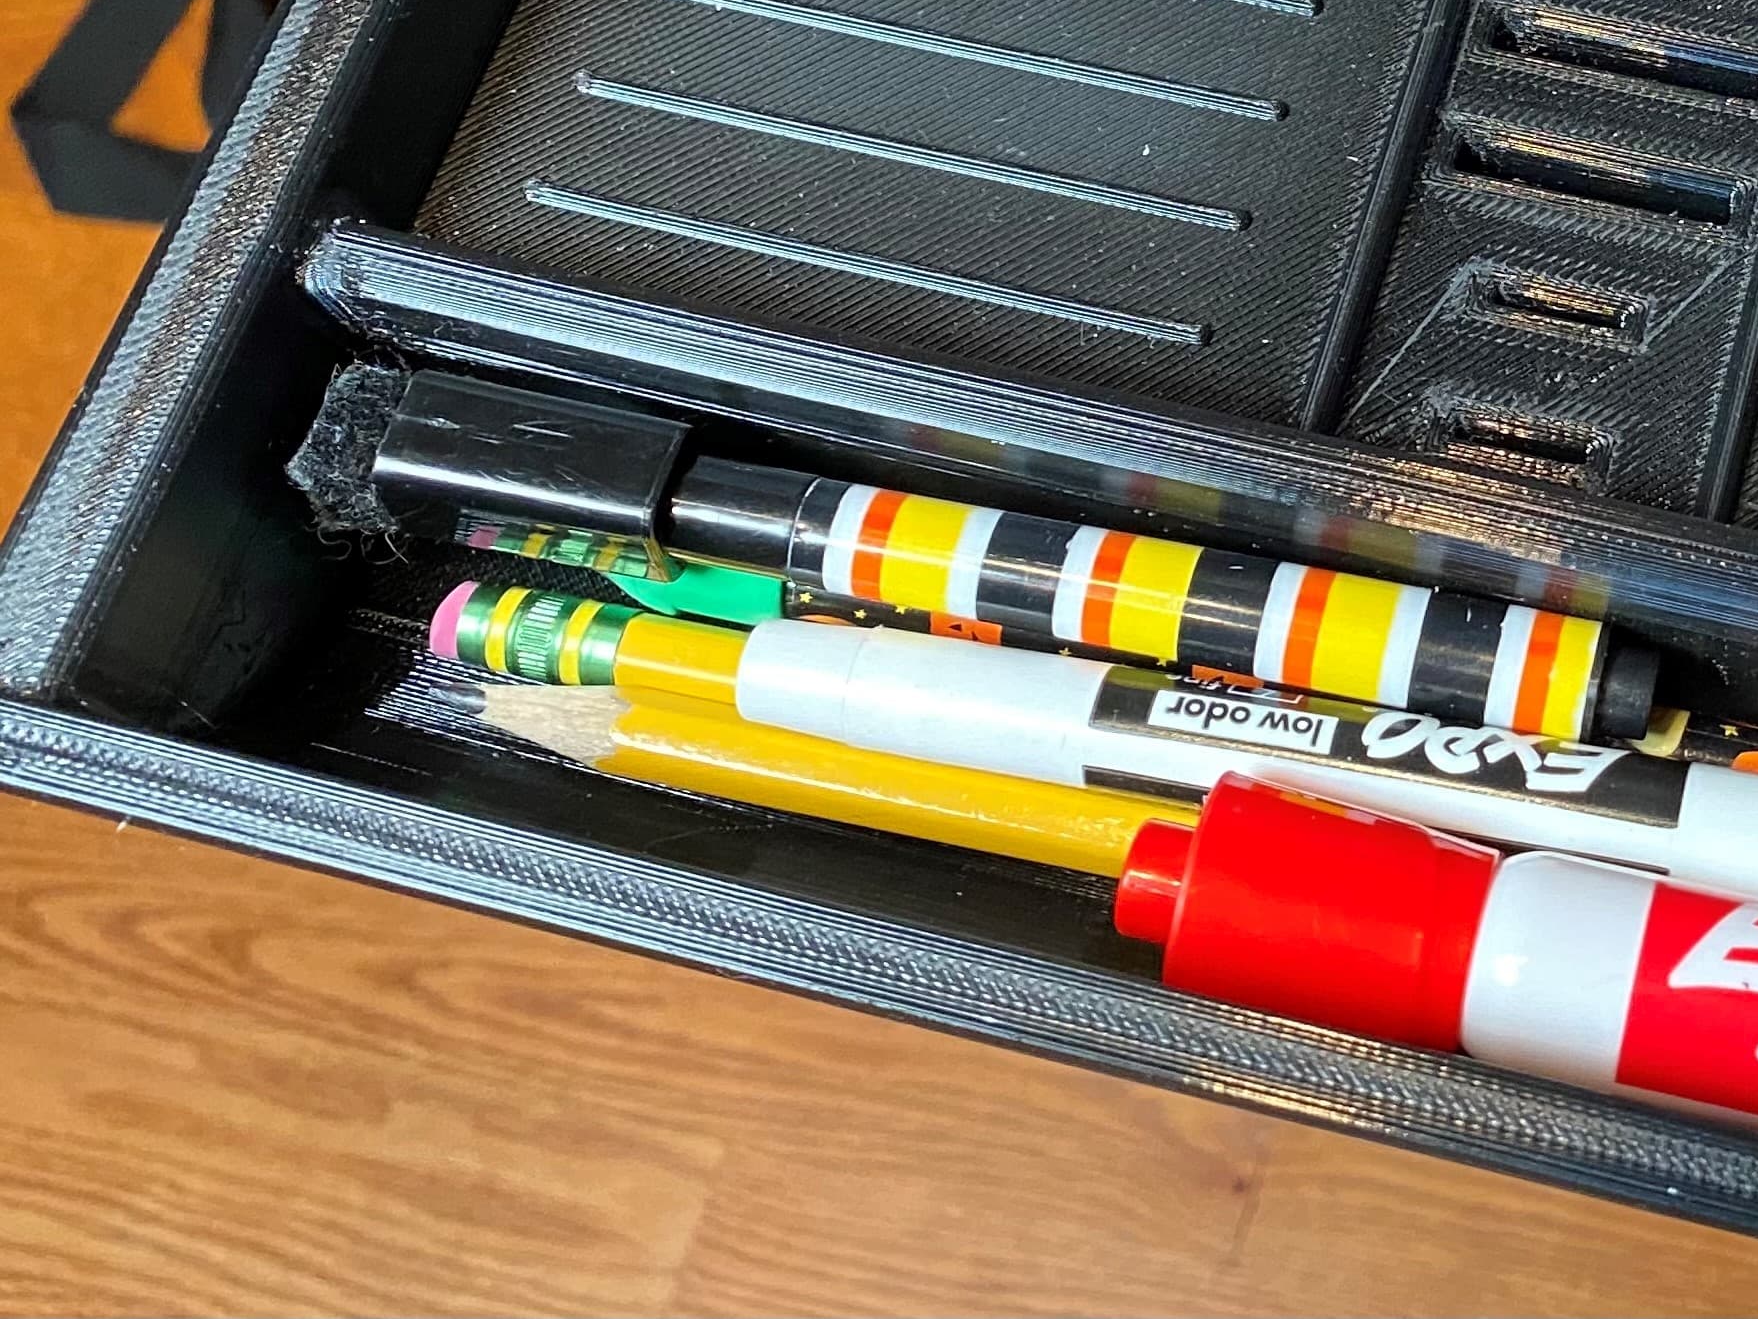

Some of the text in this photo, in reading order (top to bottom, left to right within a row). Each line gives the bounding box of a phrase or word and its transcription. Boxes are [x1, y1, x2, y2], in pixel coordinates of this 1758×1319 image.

[1166, 696, 1325, 747] low odor
[1361, 711, 1632, 792] EXPO
